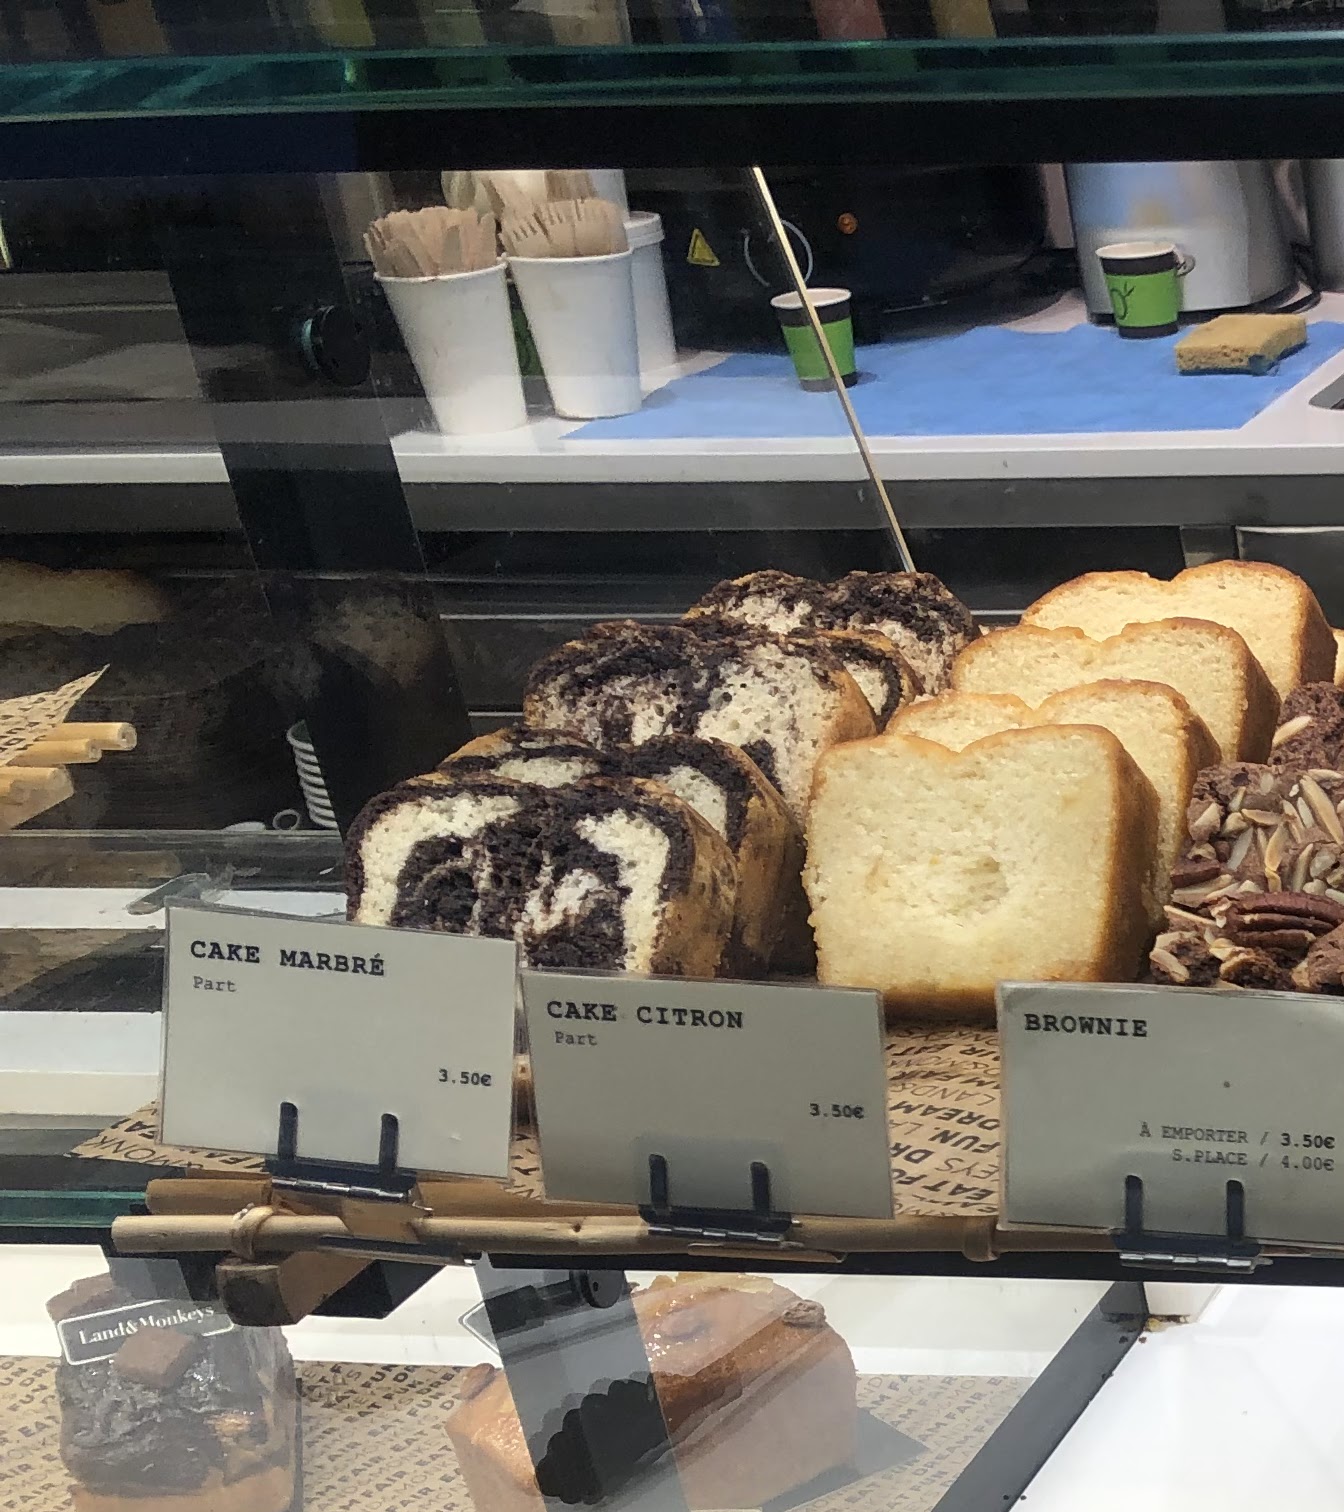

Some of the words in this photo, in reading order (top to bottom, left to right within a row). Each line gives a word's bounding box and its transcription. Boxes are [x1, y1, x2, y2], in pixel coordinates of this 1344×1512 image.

[190, 940, 261, 965] CAKE
[280, 948, 386, 978] MARBRÉ
[193, 976, 237, 994] Part
[547, 1000, 618, 1024] CAKE
[637, 1005, 744, 1031] CITRON
[1024, 1013, 1149, 1038] BROWNIE
[554, 1030, 598, 1048] Part
[438, 1068, 493, 1088] 3.50€
[808, 1102, 866, 1121] 3.50€
[1139, 1120, 1152, 1139] À
[1161, 1126, 1249, 1145] EMPORTER
[1280, 1132, 1337, 1150] 3.50€
[1172, 1149, 1248, 1167] S.PLACE
[1280, 1155, 1336, 1173] 4.00€
[79, 1305, 215, 1345] Land&Monkeys
